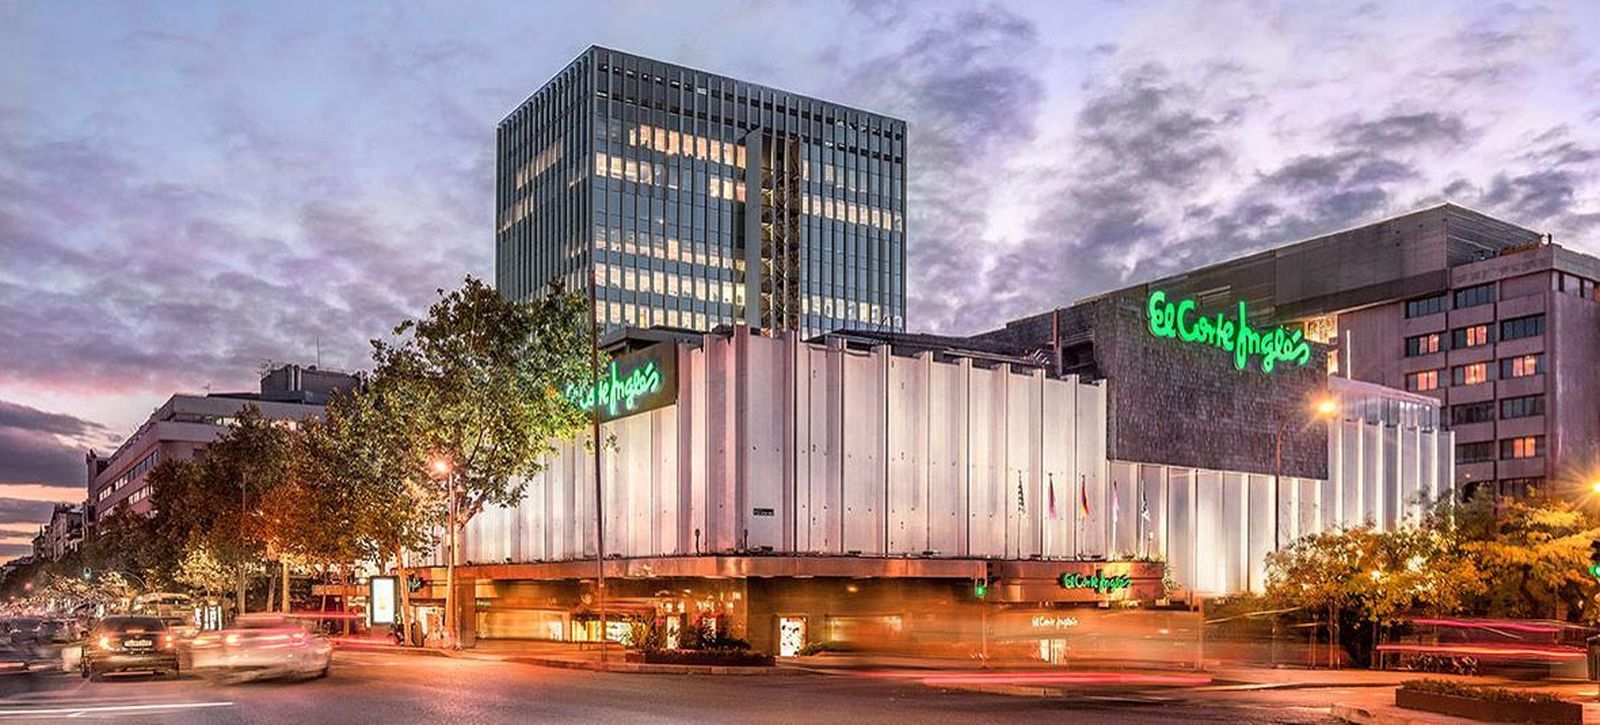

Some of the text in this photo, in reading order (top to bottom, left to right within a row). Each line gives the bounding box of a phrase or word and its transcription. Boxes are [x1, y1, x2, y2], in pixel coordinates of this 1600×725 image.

[1149, 290, 1310, 373] El Corte Inglés
[609, 361, 660, 415] Inglés
